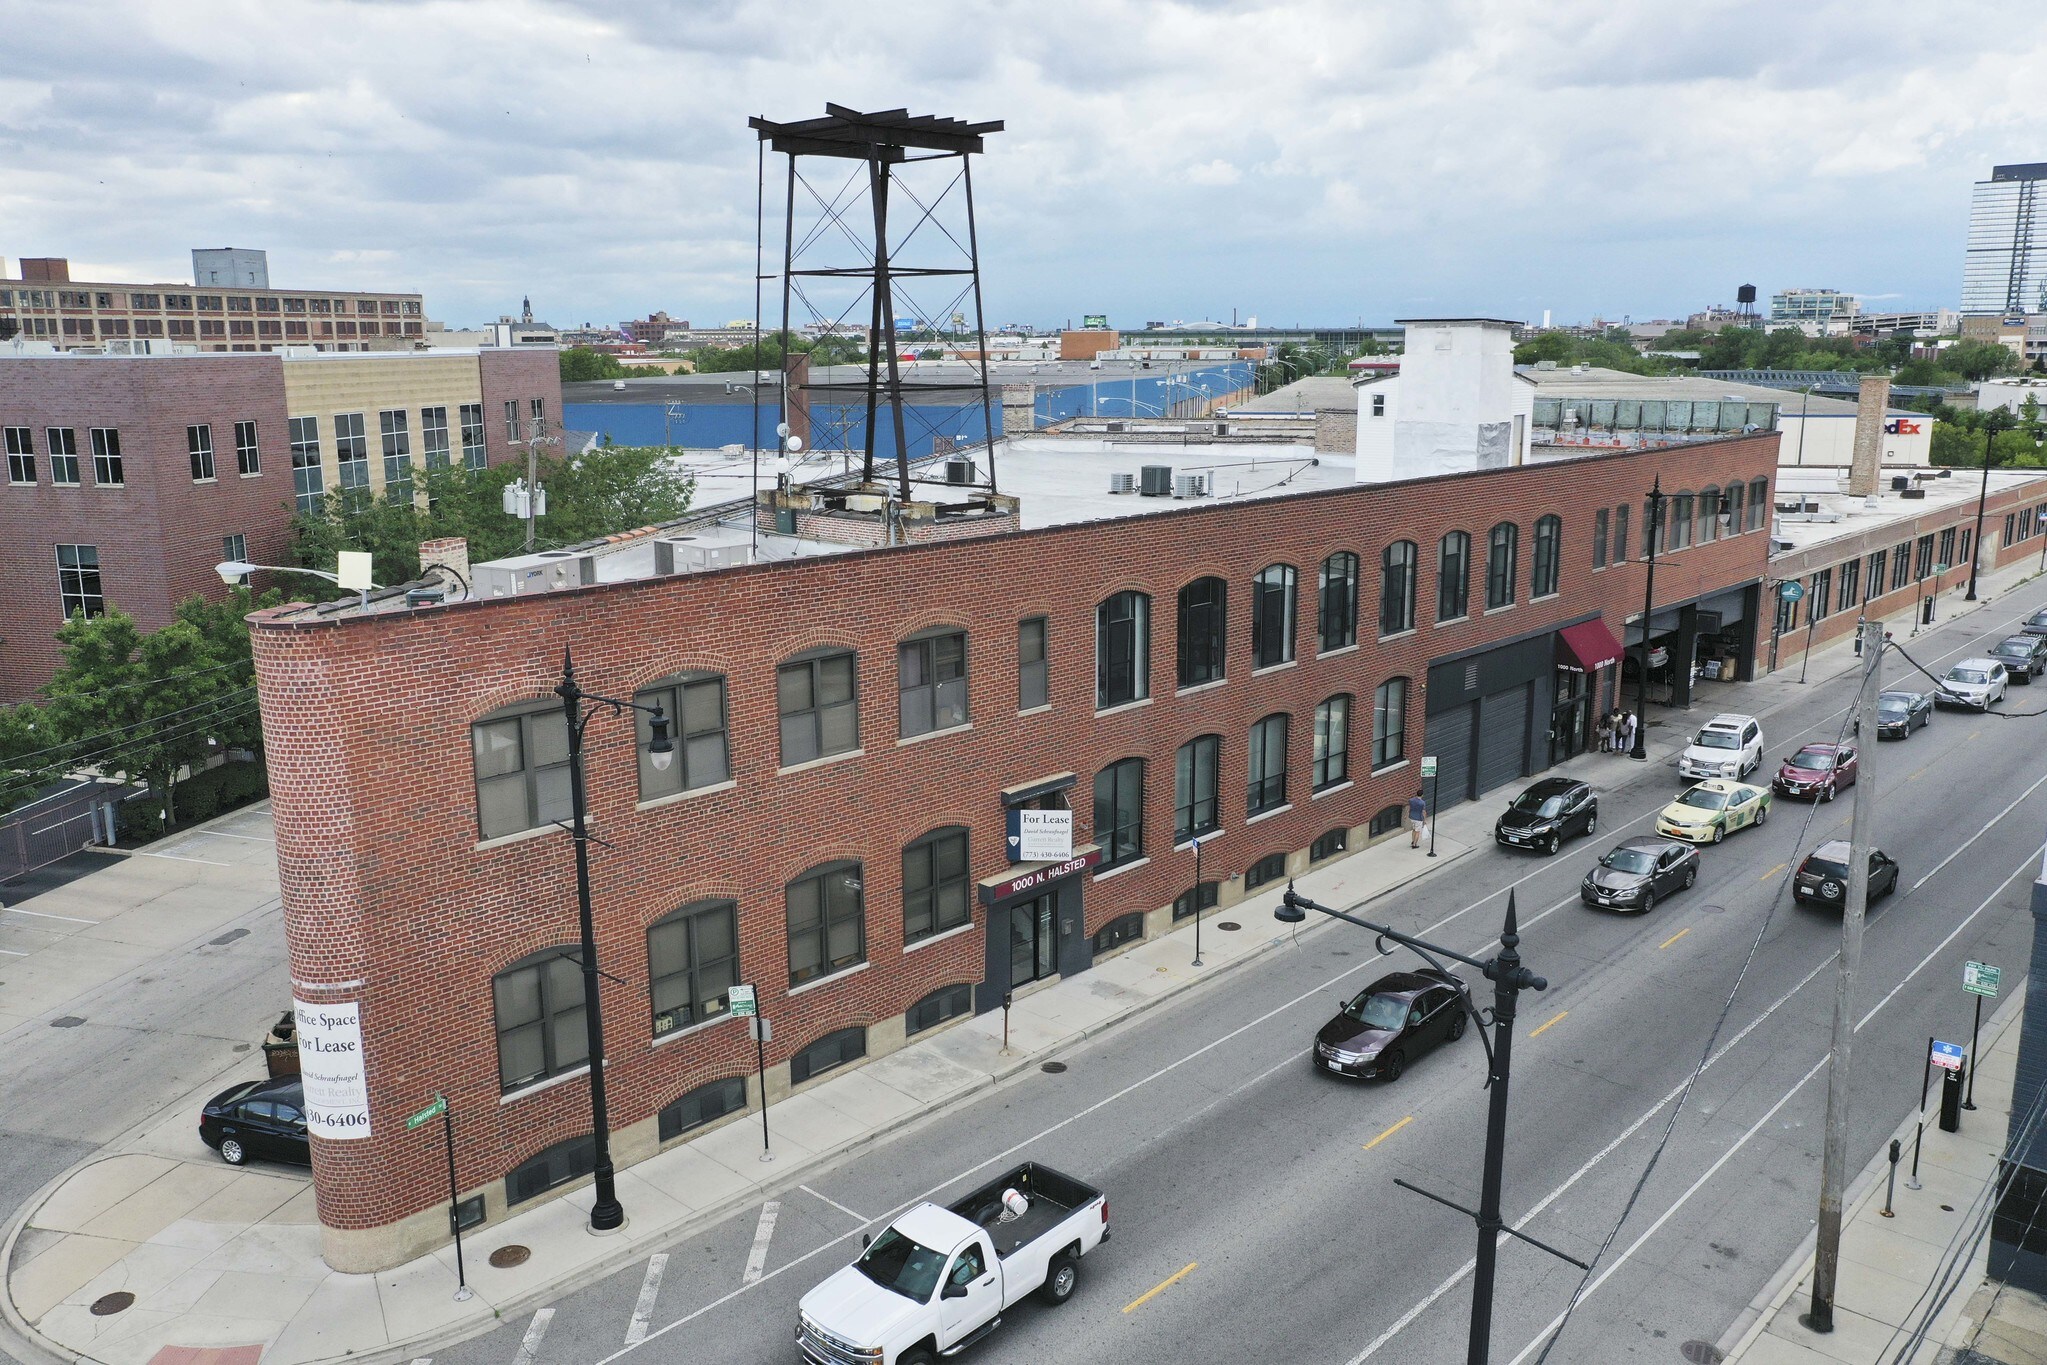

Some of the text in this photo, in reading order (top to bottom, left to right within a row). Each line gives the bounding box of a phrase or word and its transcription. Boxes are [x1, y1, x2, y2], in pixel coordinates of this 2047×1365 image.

[1884, 419, 1921, 434] dEx
[1023, 814, 1070, 824] For Lease
[1011, 857, 1086, 892] 1000 N. HALSTED
[319, 1013, 357, 1031] Space
[315, 1037, 356, 1052] Lease
[314, 1072, 358, 1084] Schraufnagel
[328, 1087, 362, 1099] Realty
[413, 1106, 437, 1125] Halsted
